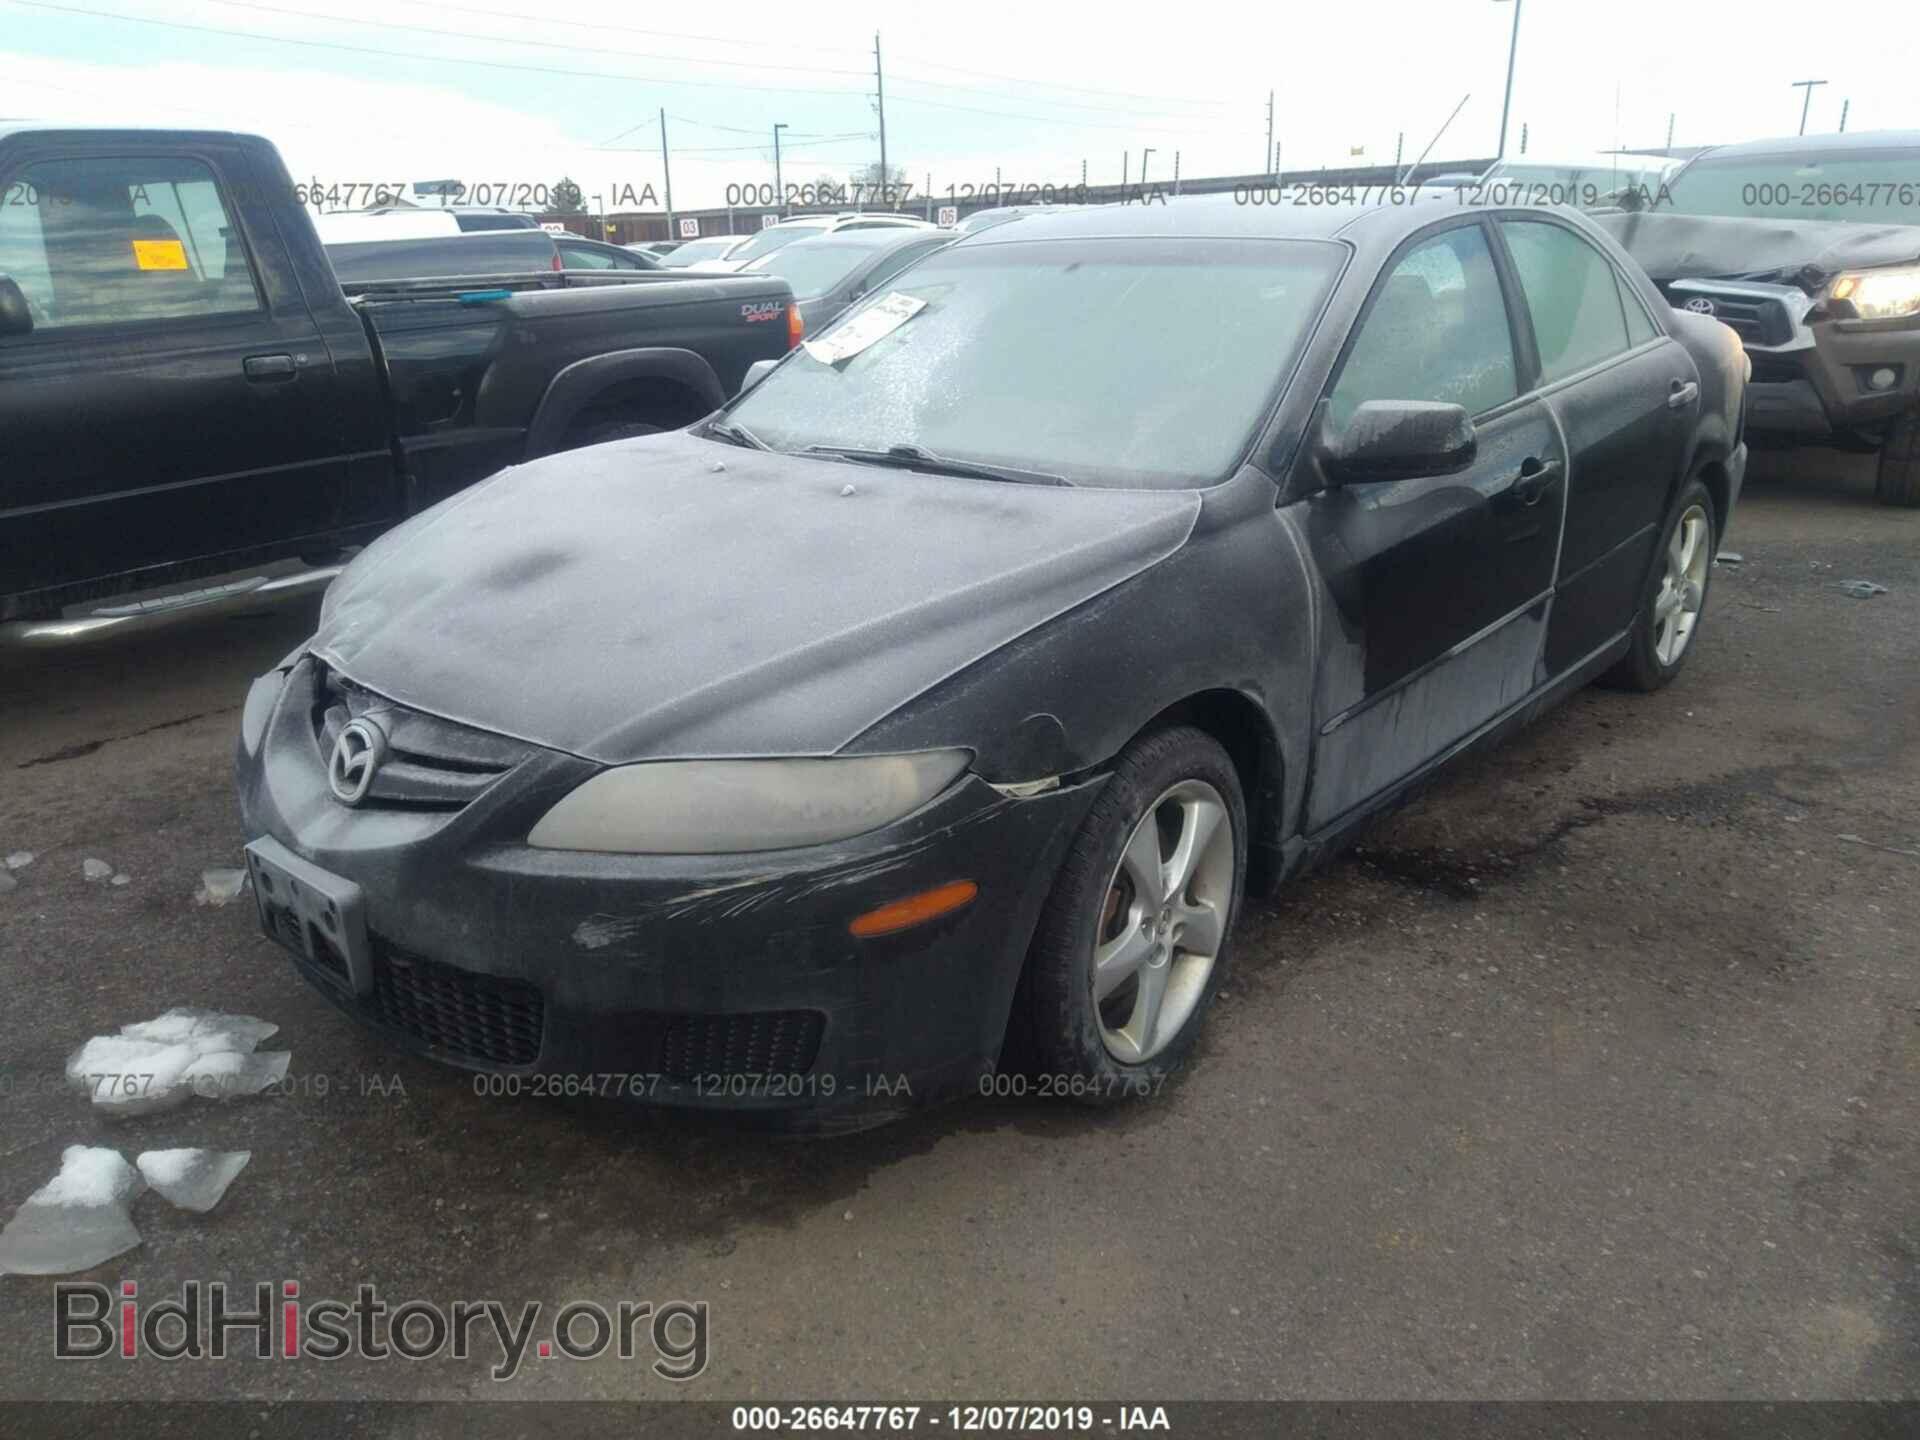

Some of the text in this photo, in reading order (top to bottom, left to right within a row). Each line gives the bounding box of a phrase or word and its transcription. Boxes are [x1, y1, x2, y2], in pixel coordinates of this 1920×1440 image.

[941, 209, 954, 224] 06
[682, 220, 696, 234] 03
[741, 301, 785, 316] DUAL
[746, 311, 780, 323] SPORT
